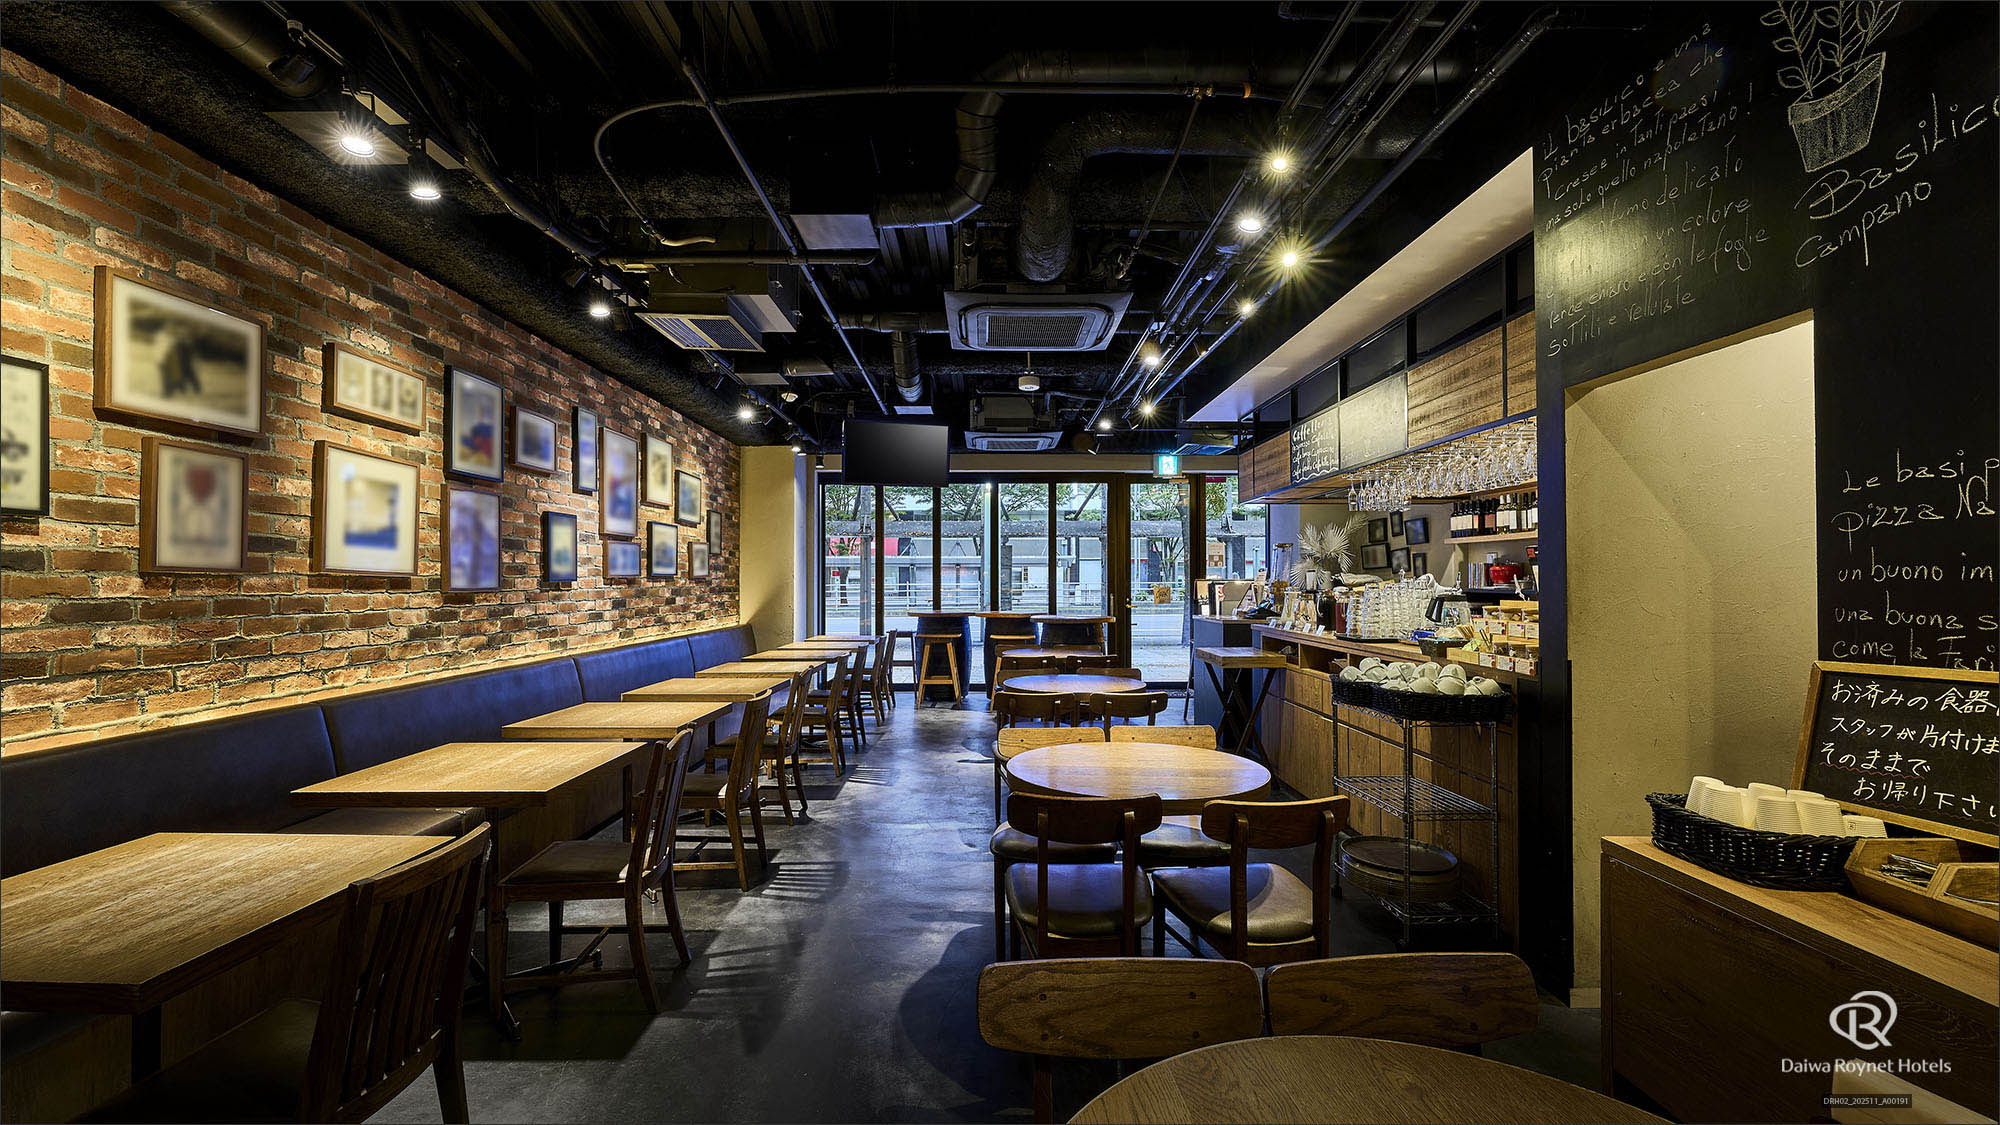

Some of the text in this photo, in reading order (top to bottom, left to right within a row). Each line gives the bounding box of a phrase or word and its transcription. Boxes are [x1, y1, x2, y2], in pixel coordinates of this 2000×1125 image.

[1601, 80, 1681, 135] erbacea
[1689, 43, 1725, 77] che
[1615, 143, 1627, 159] in
[1545, 213, 1561, 233] ma
[1597, 158, 1637, 209] quello
[1681, 186, 1752, 232] colore
[1691, 233, 1707, 266] le
[1708, 213, 1770, 274] foglie
[1608, 314, 1618, 325] e
[1842, 470, 1881, 494] Le
[1896, 447, 1966, 483] basi
[1837, 546, 1994, 584] un buono im
[1834, 607, 1874, 623] una
[1885, 590, 1964, 630] buona
[1909, 627, 1928, 662] la
[1820, 742, 1931, 777] そのままで
